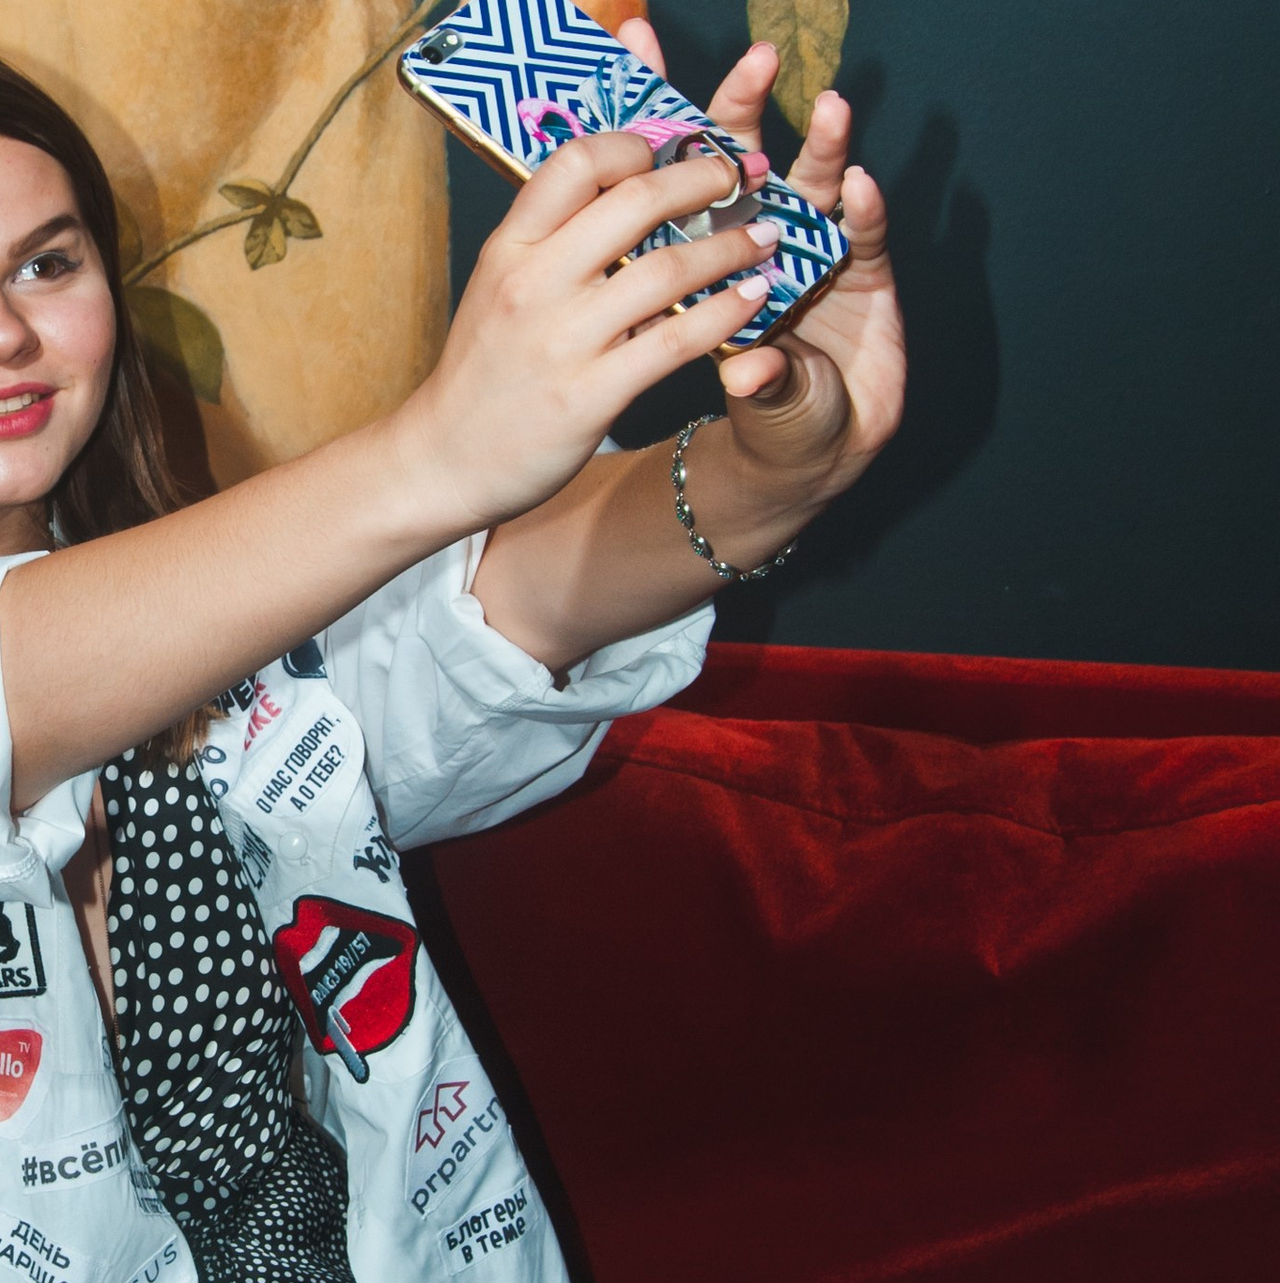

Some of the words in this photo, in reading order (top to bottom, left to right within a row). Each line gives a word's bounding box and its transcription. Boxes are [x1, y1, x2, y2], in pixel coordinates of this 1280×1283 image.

[284, 712, 342, 776] ГОВОРЯТ,
[305, 744, 346, 789] ТЕБЕ?
[262, 769, 293, 803] НАС
[298, 783, 315, 801] О
[255, 797, 273, 815] О
[289, 795, 308, 813] А
[18, 1041, 32, 1054] TV
[10, 1220, 71, 1269] ДЕНЬ
[476, 1216, 527, 1255] теме
